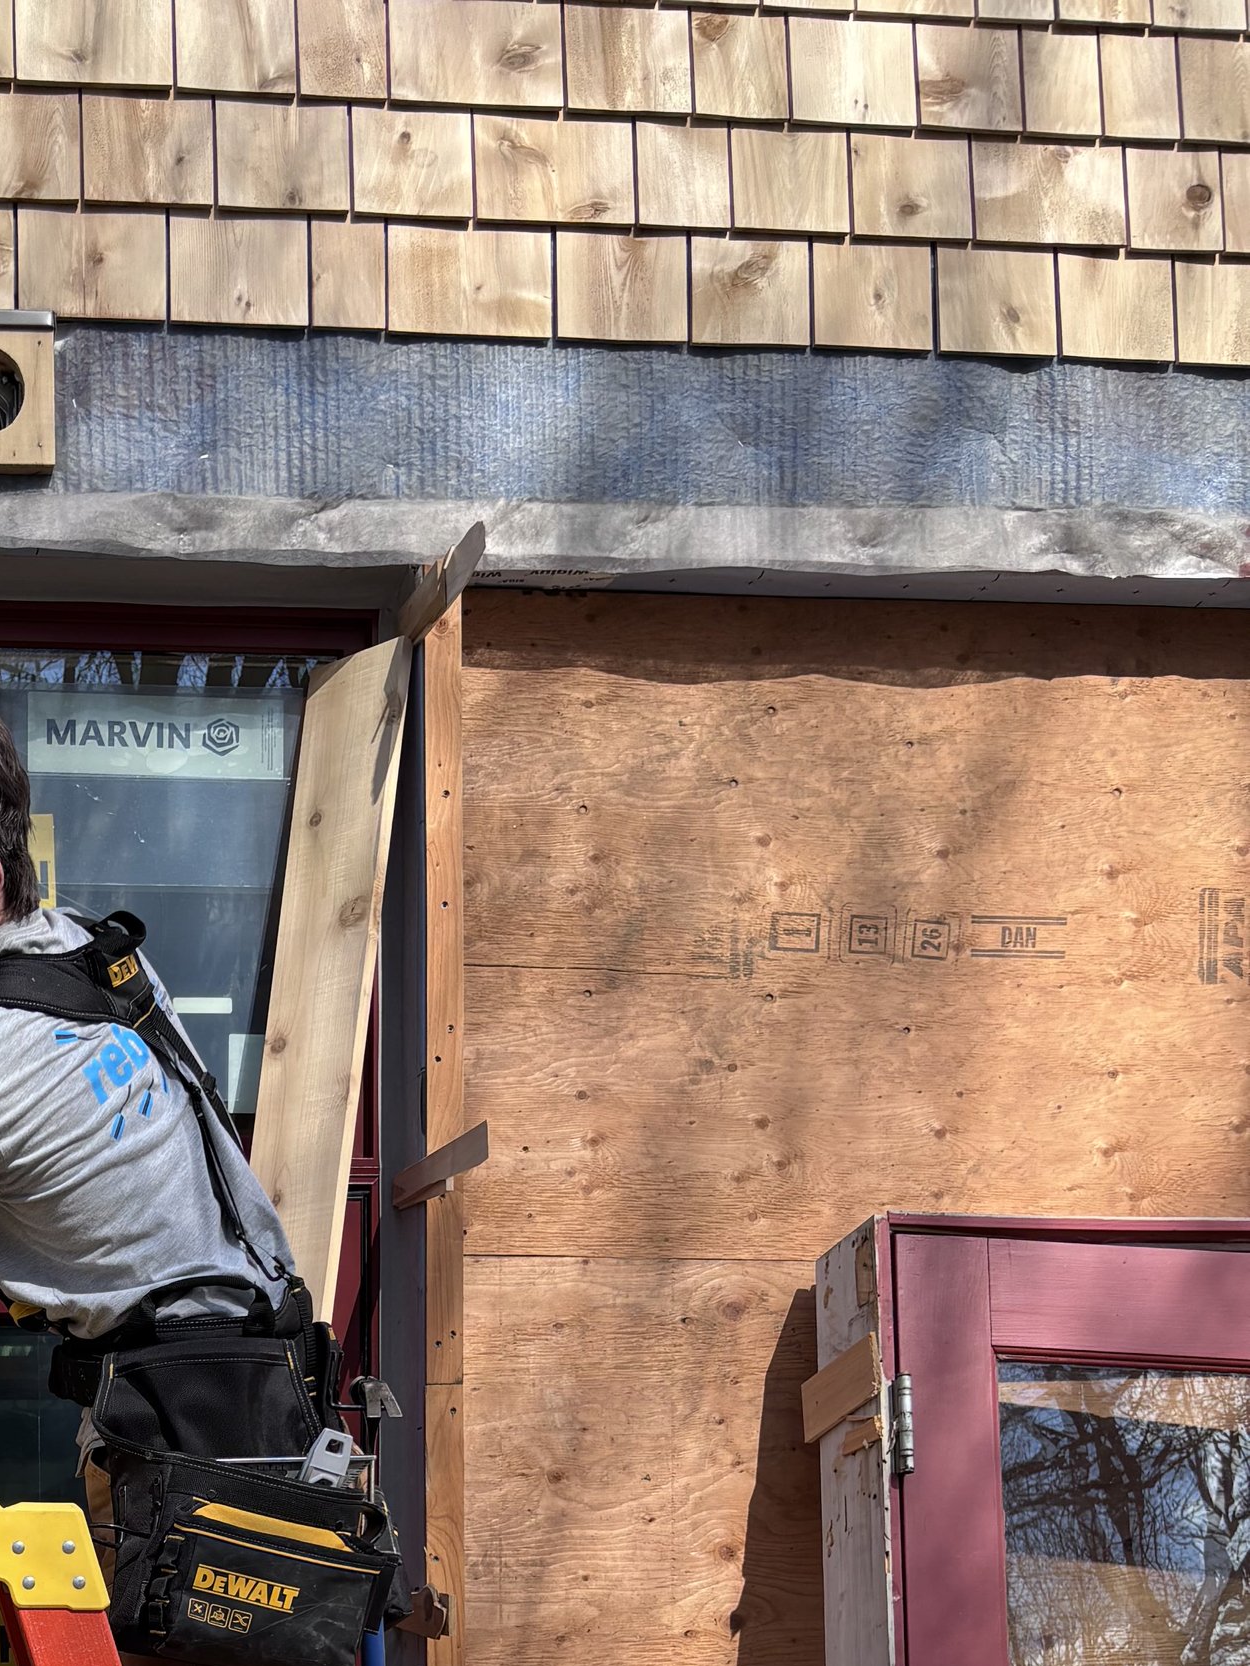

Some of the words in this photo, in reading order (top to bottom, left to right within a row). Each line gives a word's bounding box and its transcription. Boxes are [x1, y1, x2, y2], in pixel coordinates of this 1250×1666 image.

[46, 718, 191, 749] MARVIN
[920, 927, 942, 952] 26
[1000, 925, 1037, 949] DAN
